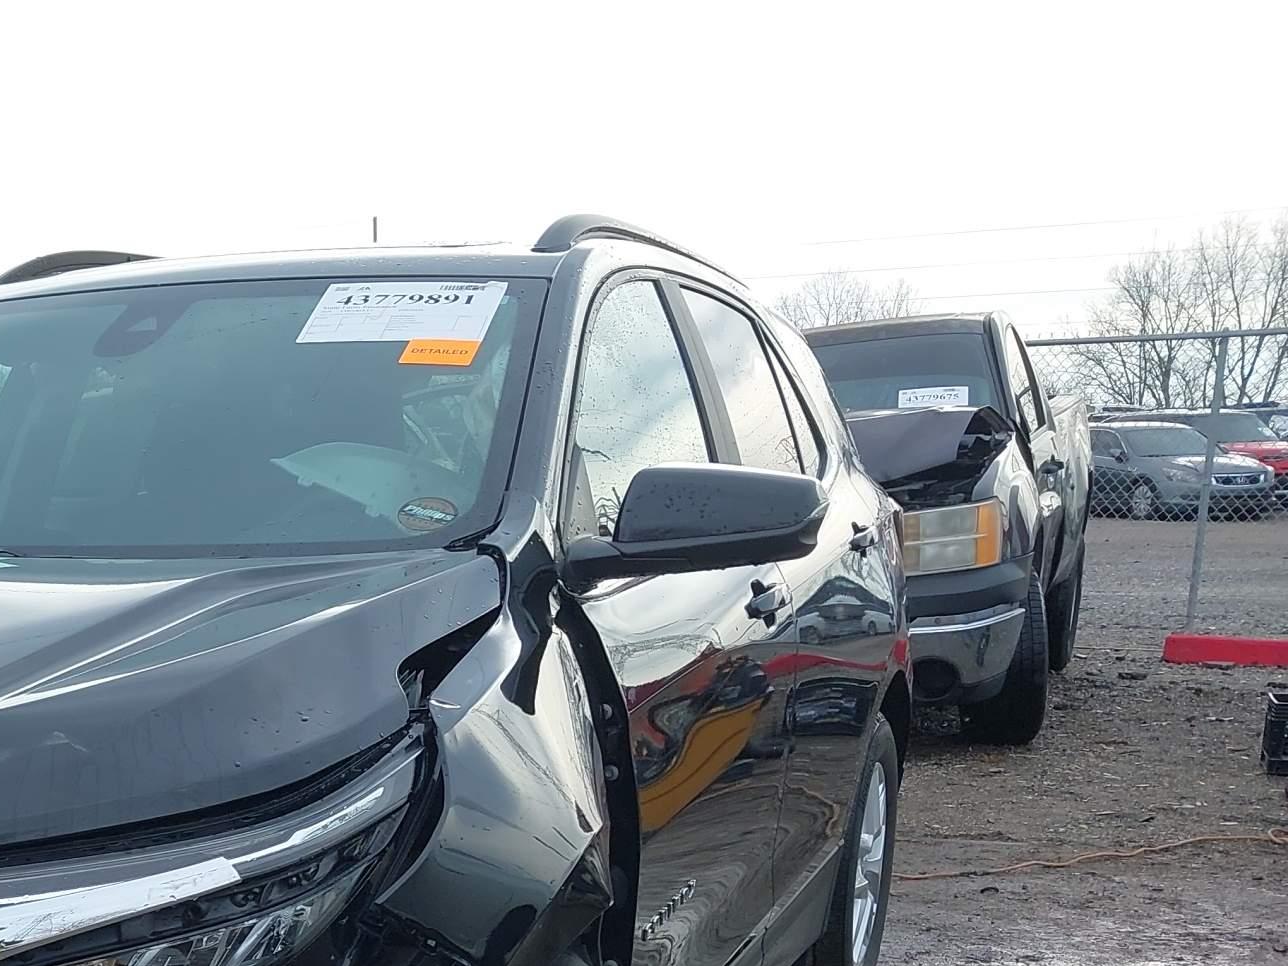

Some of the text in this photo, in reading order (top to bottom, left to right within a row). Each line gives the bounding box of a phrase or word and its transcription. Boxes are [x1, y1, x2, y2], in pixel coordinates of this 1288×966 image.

[336, 294, 474, 305] 43779891
[411, 347, 469, 355] DETAILED
[905, 393, 960, 402] 43779675
